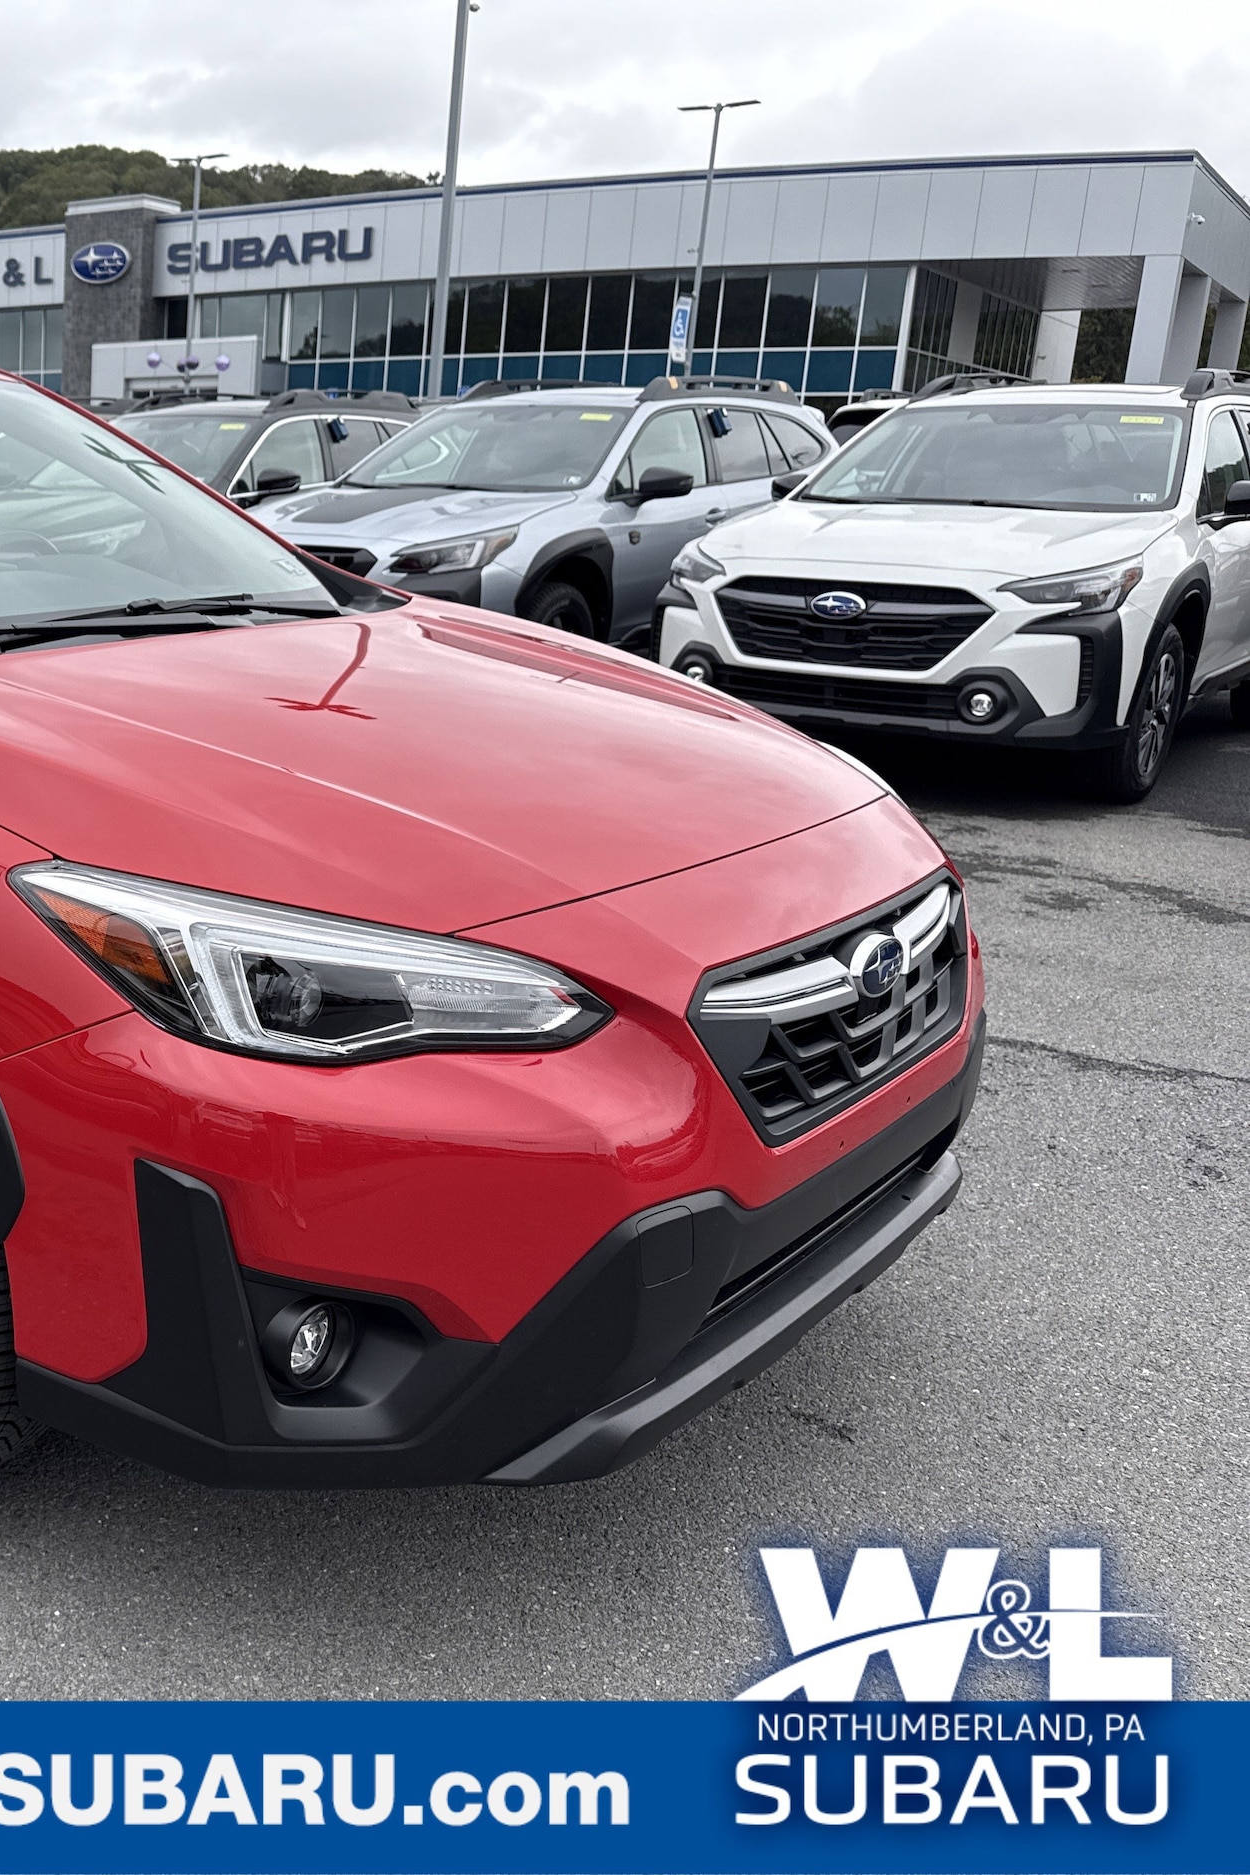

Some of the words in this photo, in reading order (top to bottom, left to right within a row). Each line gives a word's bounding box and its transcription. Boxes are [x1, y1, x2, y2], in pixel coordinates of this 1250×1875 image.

[167, 227, 374, 275] SUBARU
[3, 258, 25, 287] &
[34, 256, 54, 285] L
